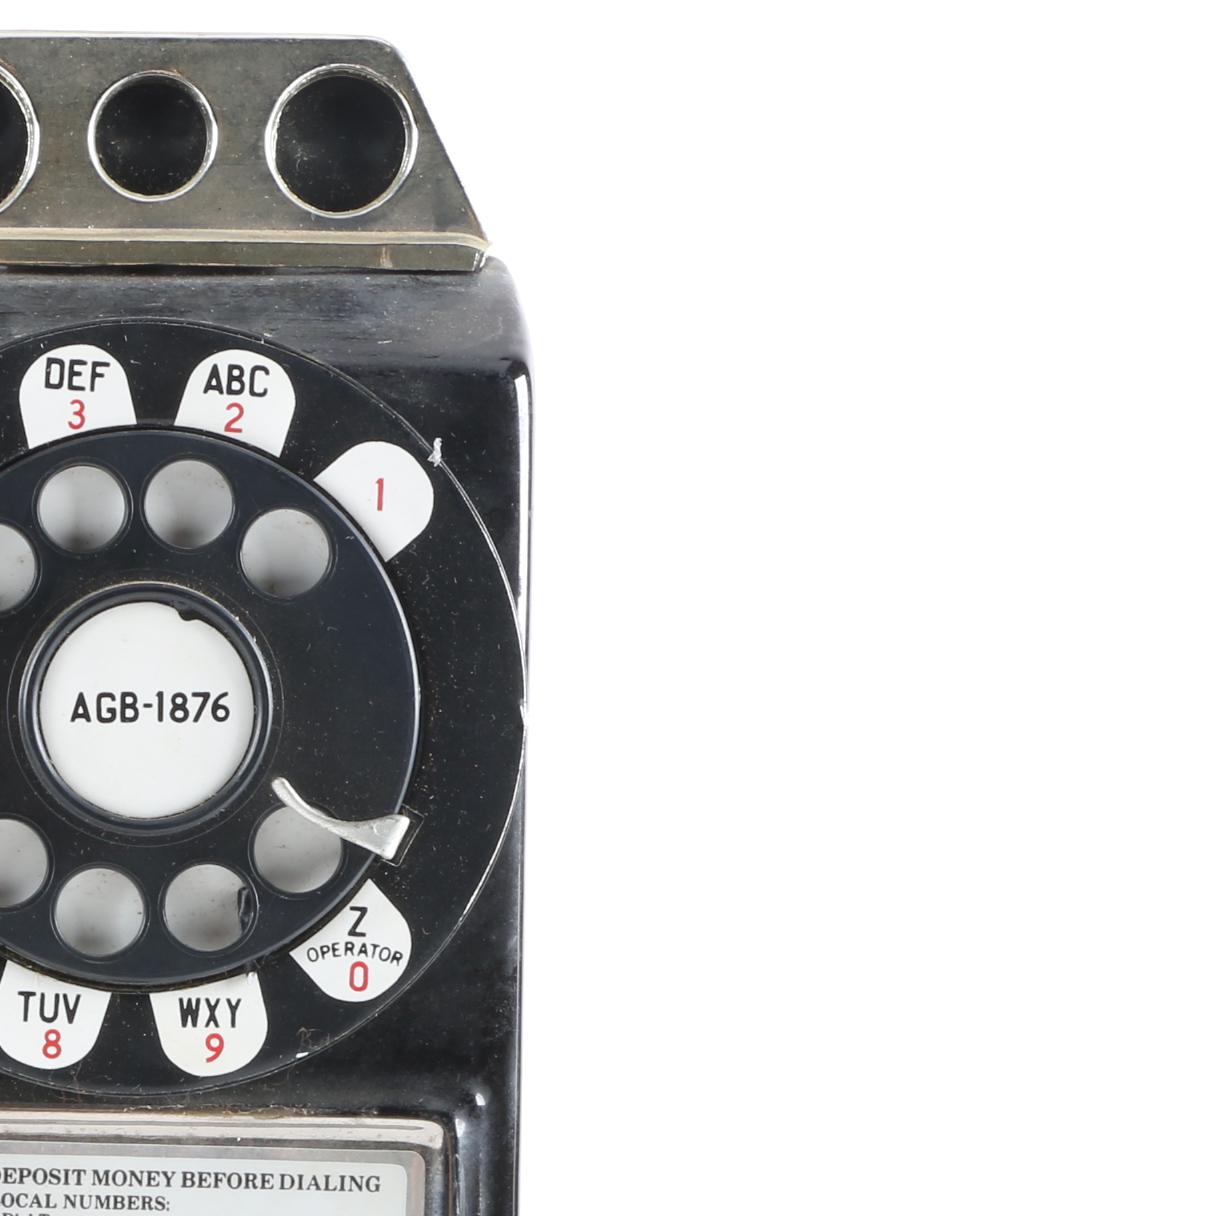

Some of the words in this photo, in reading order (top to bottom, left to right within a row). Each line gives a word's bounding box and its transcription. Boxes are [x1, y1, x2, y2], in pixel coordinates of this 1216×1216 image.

[44, 358, 111, 391] DEF
[202, 366, 270, 398] ABC
[68, 399, 86, 430] 3
[225, 403, 244, 434] 2
[374, 477, 385, 511] 1
[69, 691, 231, 725] AGB-1876
[347, 906, 368, 937] Z
[306, 941, 404, 967] OPERATOR
[349, 961, 369, 992] 0
[16, 992, 82, 1024] TUV
[178, 997, 243, 1029] WXY
[42, 1029, 62, 1059] 8
[204, 1033, 225, 1063] 9
[91, 1170, 176, 1188] MONEY
[181, 1171, 274, 1190] BEFORE
[279, 1174, 381, 1192] DIALING
[63, 1194, 170, 1211] NUMBERS:
